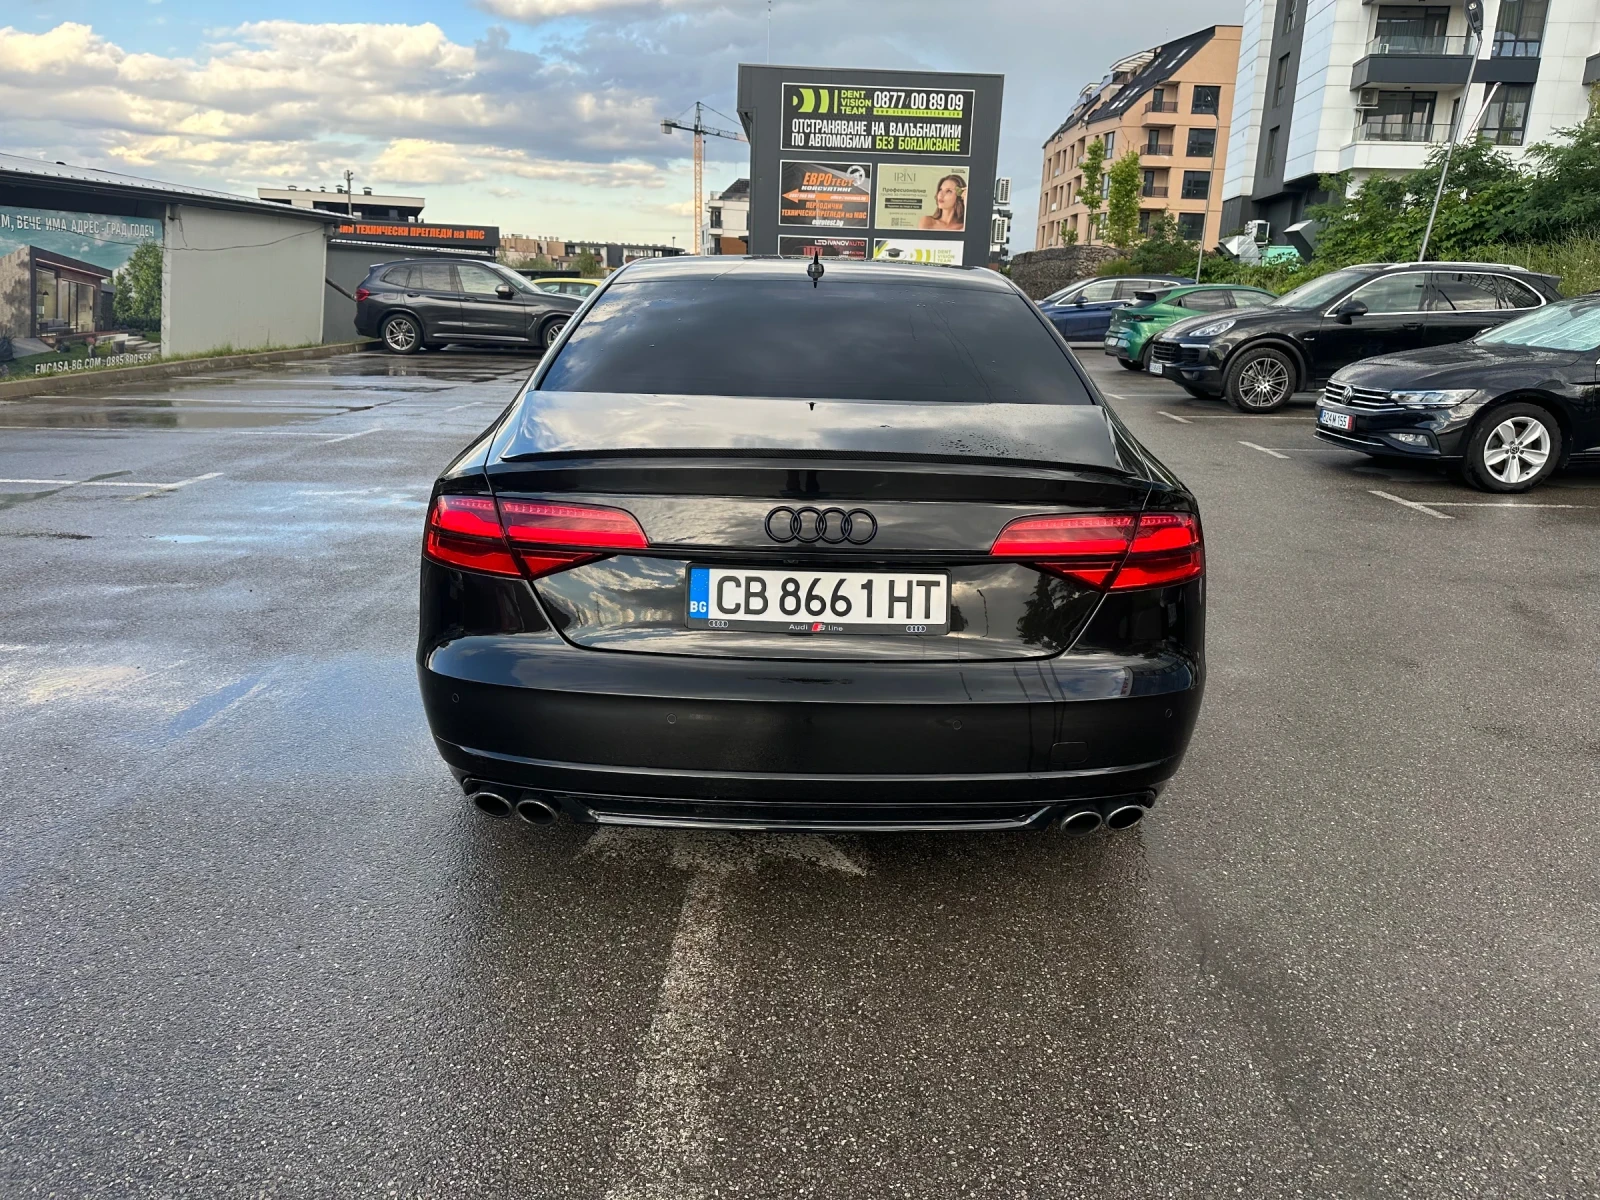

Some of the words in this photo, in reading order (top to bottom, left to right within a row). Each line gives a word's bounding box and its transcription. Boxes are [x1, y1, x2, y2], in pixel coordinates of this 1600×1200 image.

[841, 90, 866, 99] DENT
[841, 98, 871, 107] VISION
[873, 91, 905, 108] 0877
[910, 92, 927, 109] 00
[929, 93, 945, 110] 89
[947, 94, 964, 111] 09
[841, 106, 866, 115] TEAM
[792, 118, 868, 135] ОТСТРАНЯВАНЕ
[871, 121, 885, 136] НА
[889, 122, 962, 138] ВДЛЪБНАТИНИ
[791, 132, 805, 147] ПО
[808, 133, 872, 149] АВТОМОБИЛИ
[875, 136, 895, 150] БЕЗ
[898, 136, 960, 152] БОЯДИСВАНЕ
[17, 214, 42, 231] ВЕЧЕ
[45, 217, 67, 233] ИМА
[71, 219, 100, 235] АДРЕС
[106, 222, 127, 237] ГРАД
[130, 223, 155, 238] ГОДЕЧ
[356, 224, 408, 237] ТЕХНИЧЕСКИ
[410, 228, 451, 239] ПРЕГЛЕДИ
[453, 231, 465, 239] на
[466, 229, 485, 240] МПС
[716, 575, 769, 615] CB
[778, 577, 875, 618] 8661
[887, 579, 941, 620] HT
[690, 600, 707, 613] BG
[828, 624, 844, 632] line
